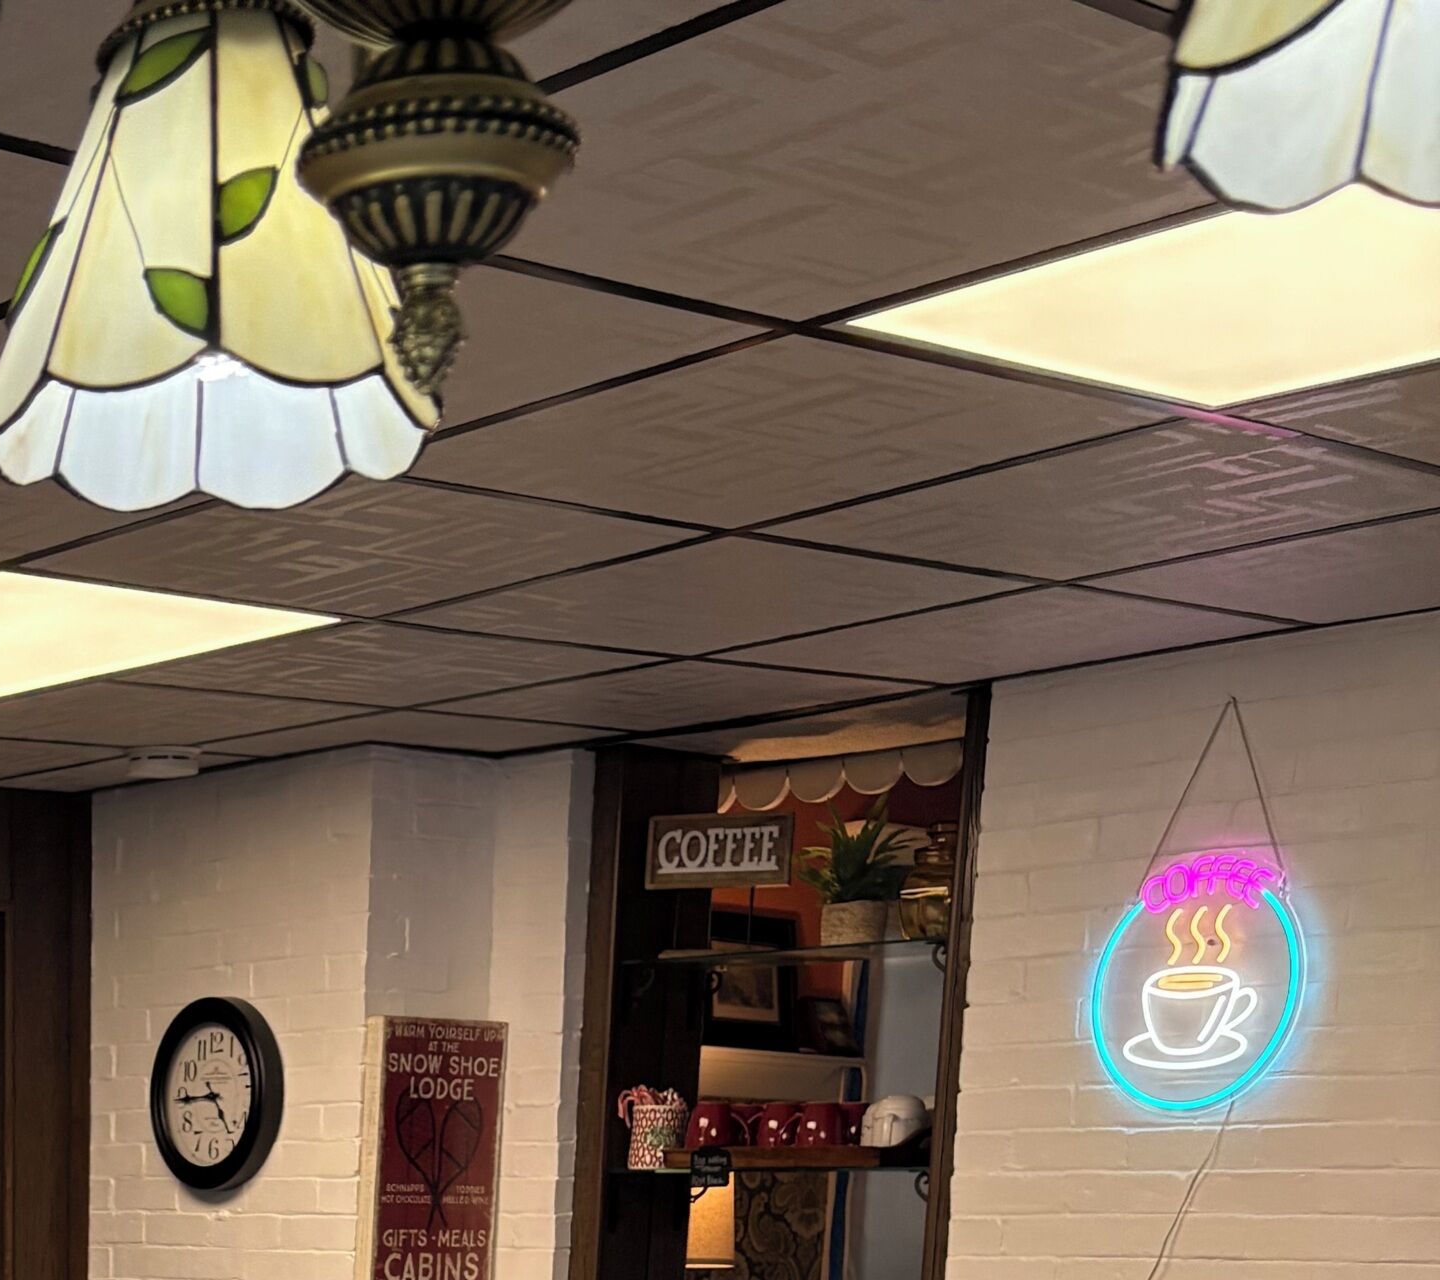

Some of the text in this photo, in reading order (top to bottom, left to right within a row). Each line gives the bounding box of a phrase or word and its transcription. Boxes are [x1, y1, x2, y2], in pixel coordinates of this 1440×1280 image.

[657, 826, 779, 873] COFFEE
[1143, 855, 1276, 913] COFFEE
[209, 1031, 224, 1053] 12
[394, 1024, 497, 1041] WARM YOURSELF UP
[197, 1040, 207, 1060] 11
[428, 1041, 460, 1053] AT THE
[183, 1060, 198, 1082] 10
[388, 1053, 499, 1077] SNOW SHOE
[409, 1076, 474, 1101] LODGE
[182, 1110, 193, 1133] 8
[208, 1138, 219, 1160] 6
[396, 1195, 432, 1204] CHOCOLATE
[382, 1229, 486, 1248] GIFTS MEALS
